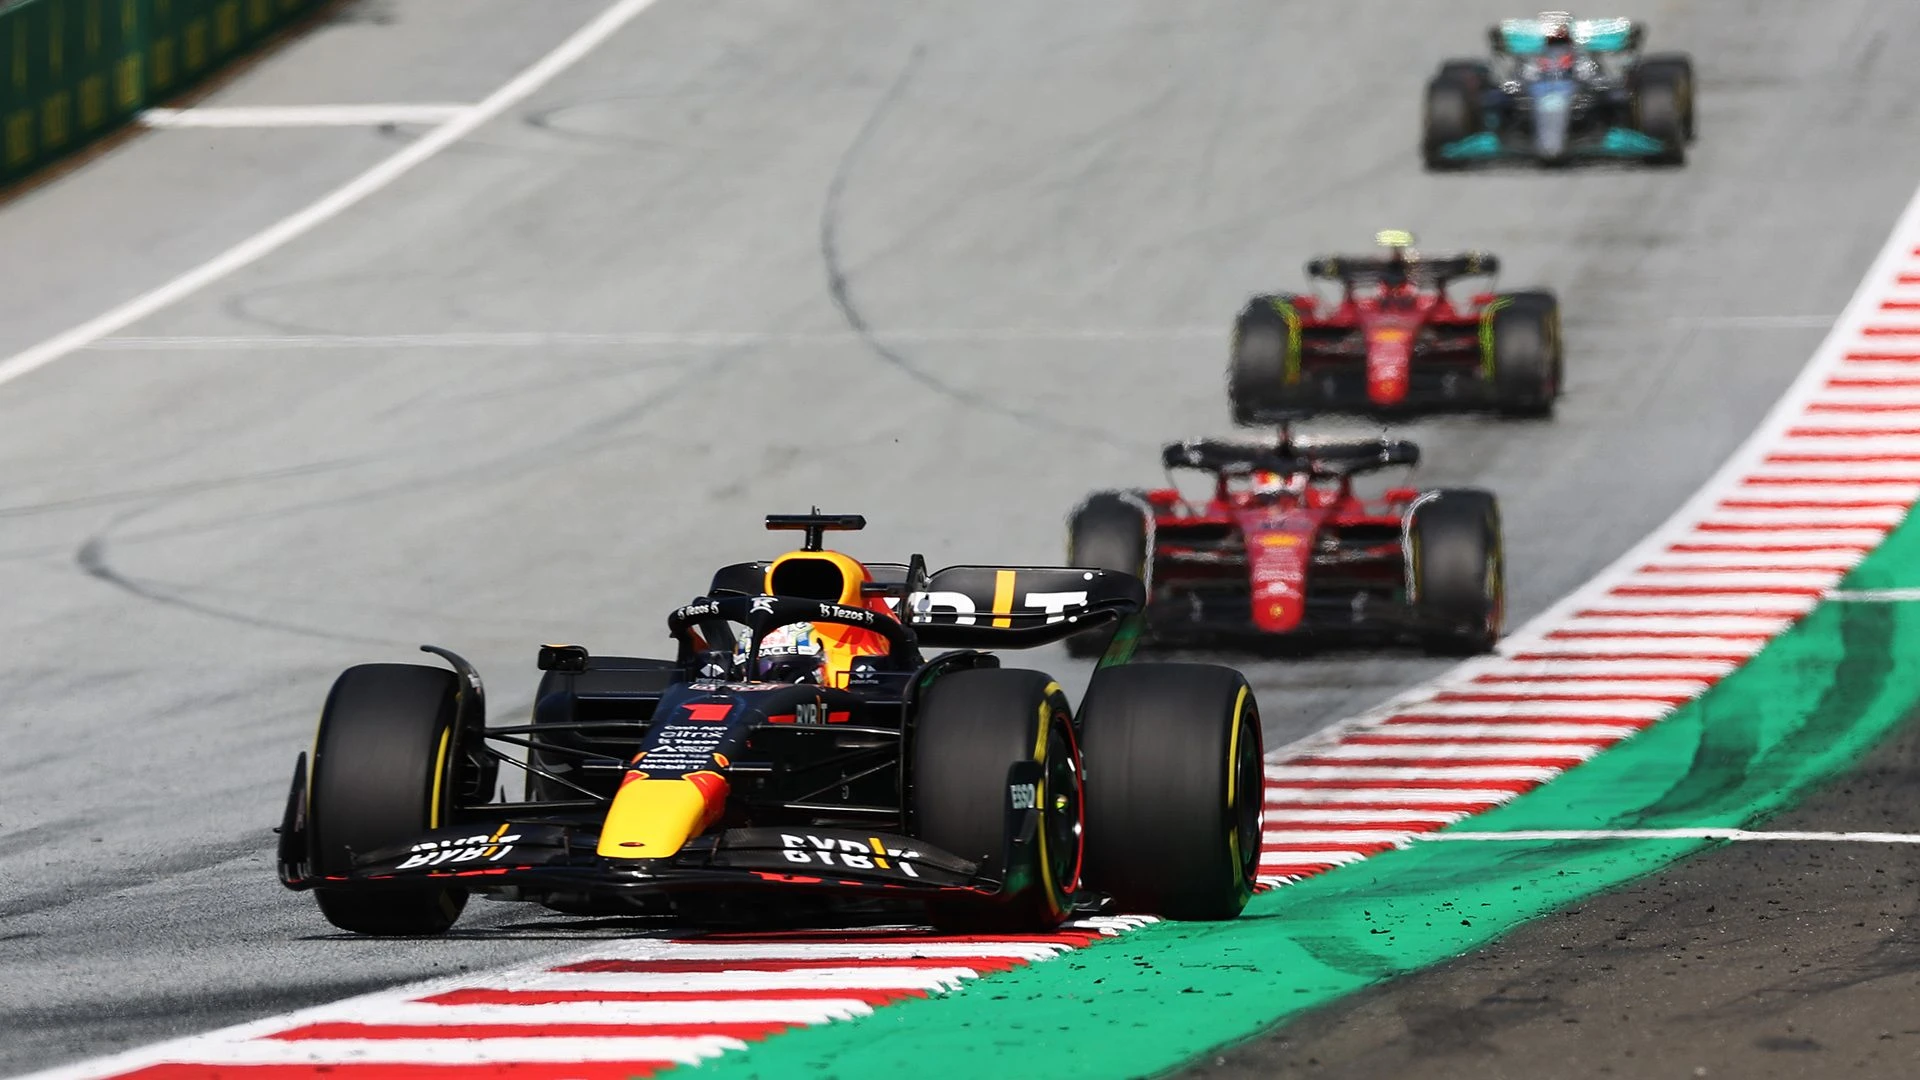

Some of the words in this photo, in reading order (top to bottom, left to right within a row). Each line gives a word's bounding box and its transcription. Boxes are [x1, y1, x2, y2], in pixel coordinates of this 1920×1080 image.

[686, 604, 709, 616] Tezos
[832, 605, 863, 621] Tezos
[681, 703, 733, 721] 1
